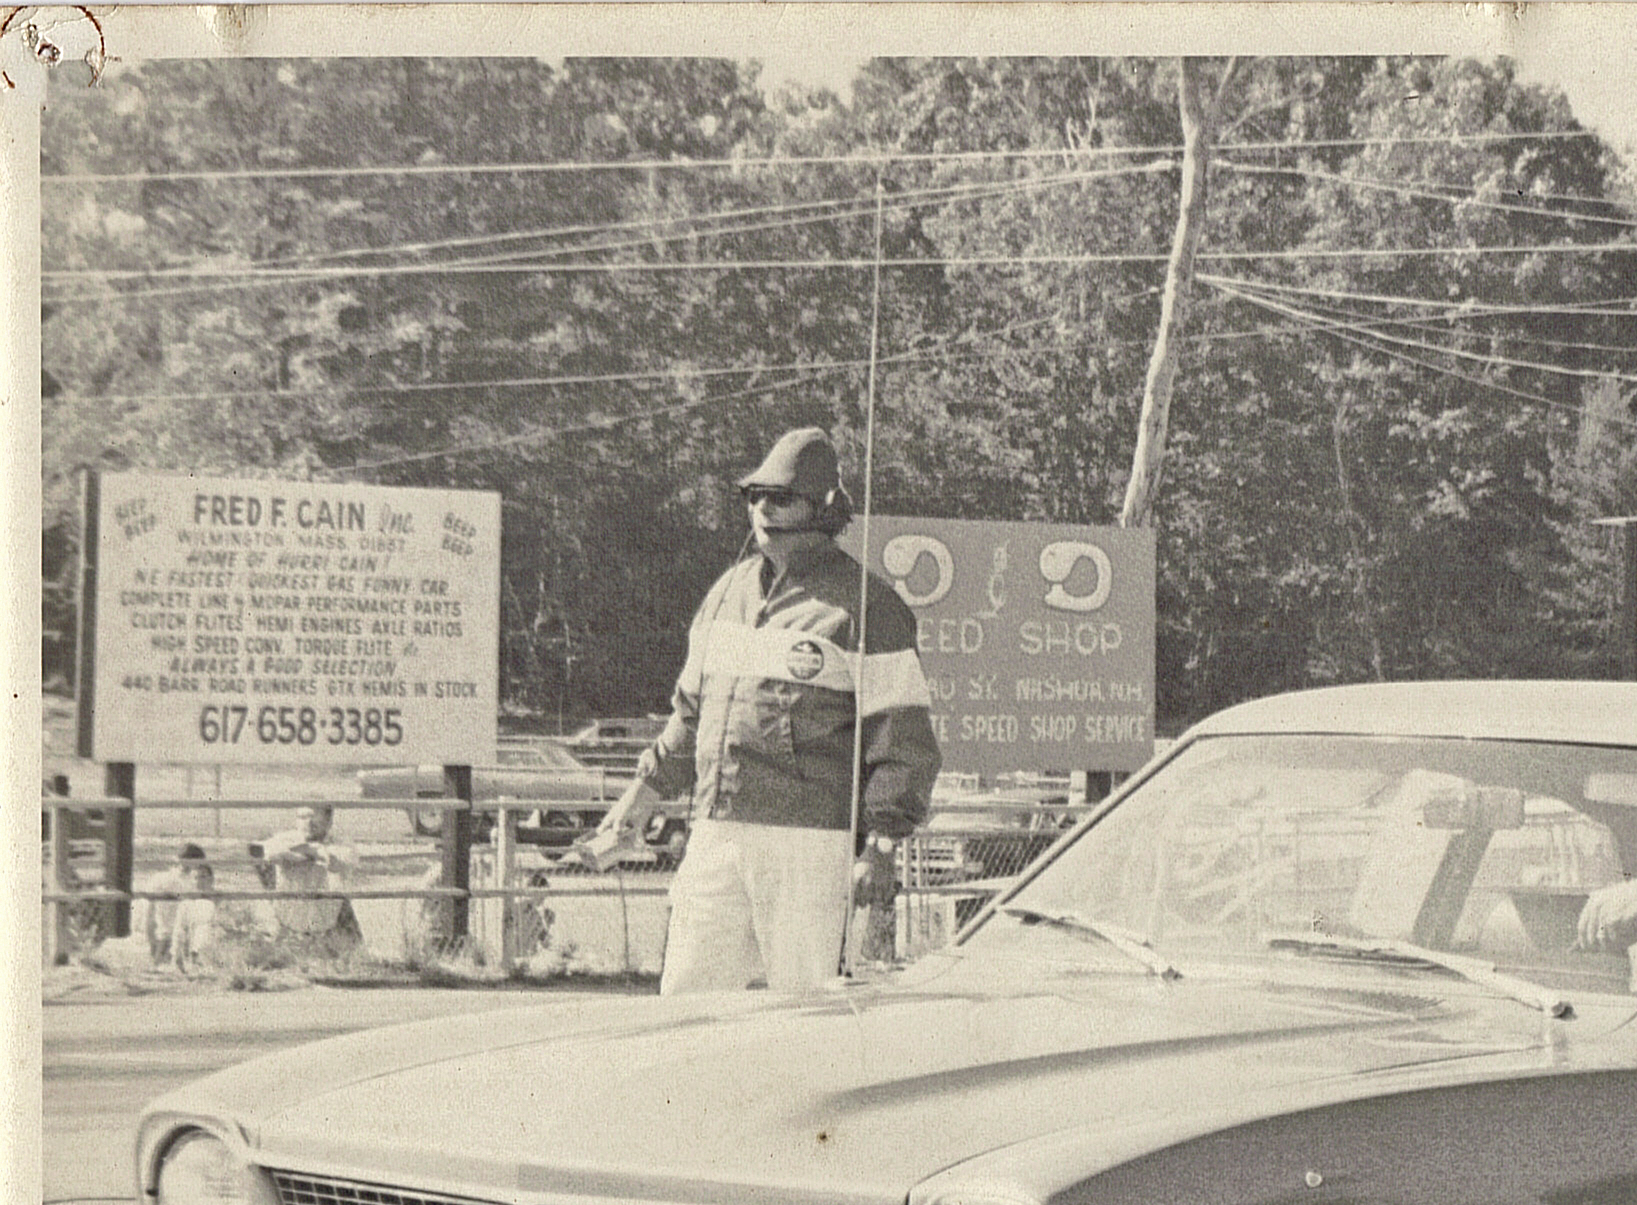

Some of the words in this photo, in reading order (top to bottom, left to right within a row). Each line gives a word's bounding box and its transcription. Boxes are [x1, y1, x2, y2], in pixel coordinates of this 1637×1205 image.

[194, 494, 263, 527] FRED
[270, 497, 288, 528] F.
[297, 499, 366, 532] CAIN
[443, 511, 477, 538] BEEP
[177, 529, 285, 548] WILMINGTON
[442, 534, 474, 556] BEEP
[186, 550, 237, 568] HOME
[246, 551, 266, 569] OF
[168, 569, 234, 588] FASTEST
[327, 574, 356, 594] GAS
[363, 576, 412, 596] FUNNY
[420, 577, 450, 597] CAR
[120, 590, 191, 609] COMPLETE
[199, 592, 228, 610] LINE
[250, 593, 301, 611] MOPAR
[307, 595, 407, 617] PERFORMANCE
[414, 599, 463, 618] PARTS
[131, 611, 187, 631] CLUTCH
[257, 615, 294, 633] HEMI
[301, 616, 363, 636] ENGINES
[371, 619, 405, 637] AXLE
[413, 619, 464, 639] RATIOS
[916, 617, 984, 654] EED
[1018, 619, 1124, 656] SHOP
[194, 633, 239, 654] SPEED
[296, 636, 348, 657] TORQUE
[170, 655, 239, 675] ALWAYS
[246, 657, 256, 674] A
[311, 658, 398, 678] SELECTION
[121, 675, 153, 692] 440
[209, 677, 248, 695] ROAD
[253, 678, 318, 696] RUNNERS
[363, 680, 407, 698] HEMIS
[414, 681, 430, 698] IN
[435, 681, 478, 699] STOCK
[961, 713, 1019, 743] SPEED
[1030, 714, 1078, 743] SHOP
[1084, 715, 1147, 744] SERVICE
